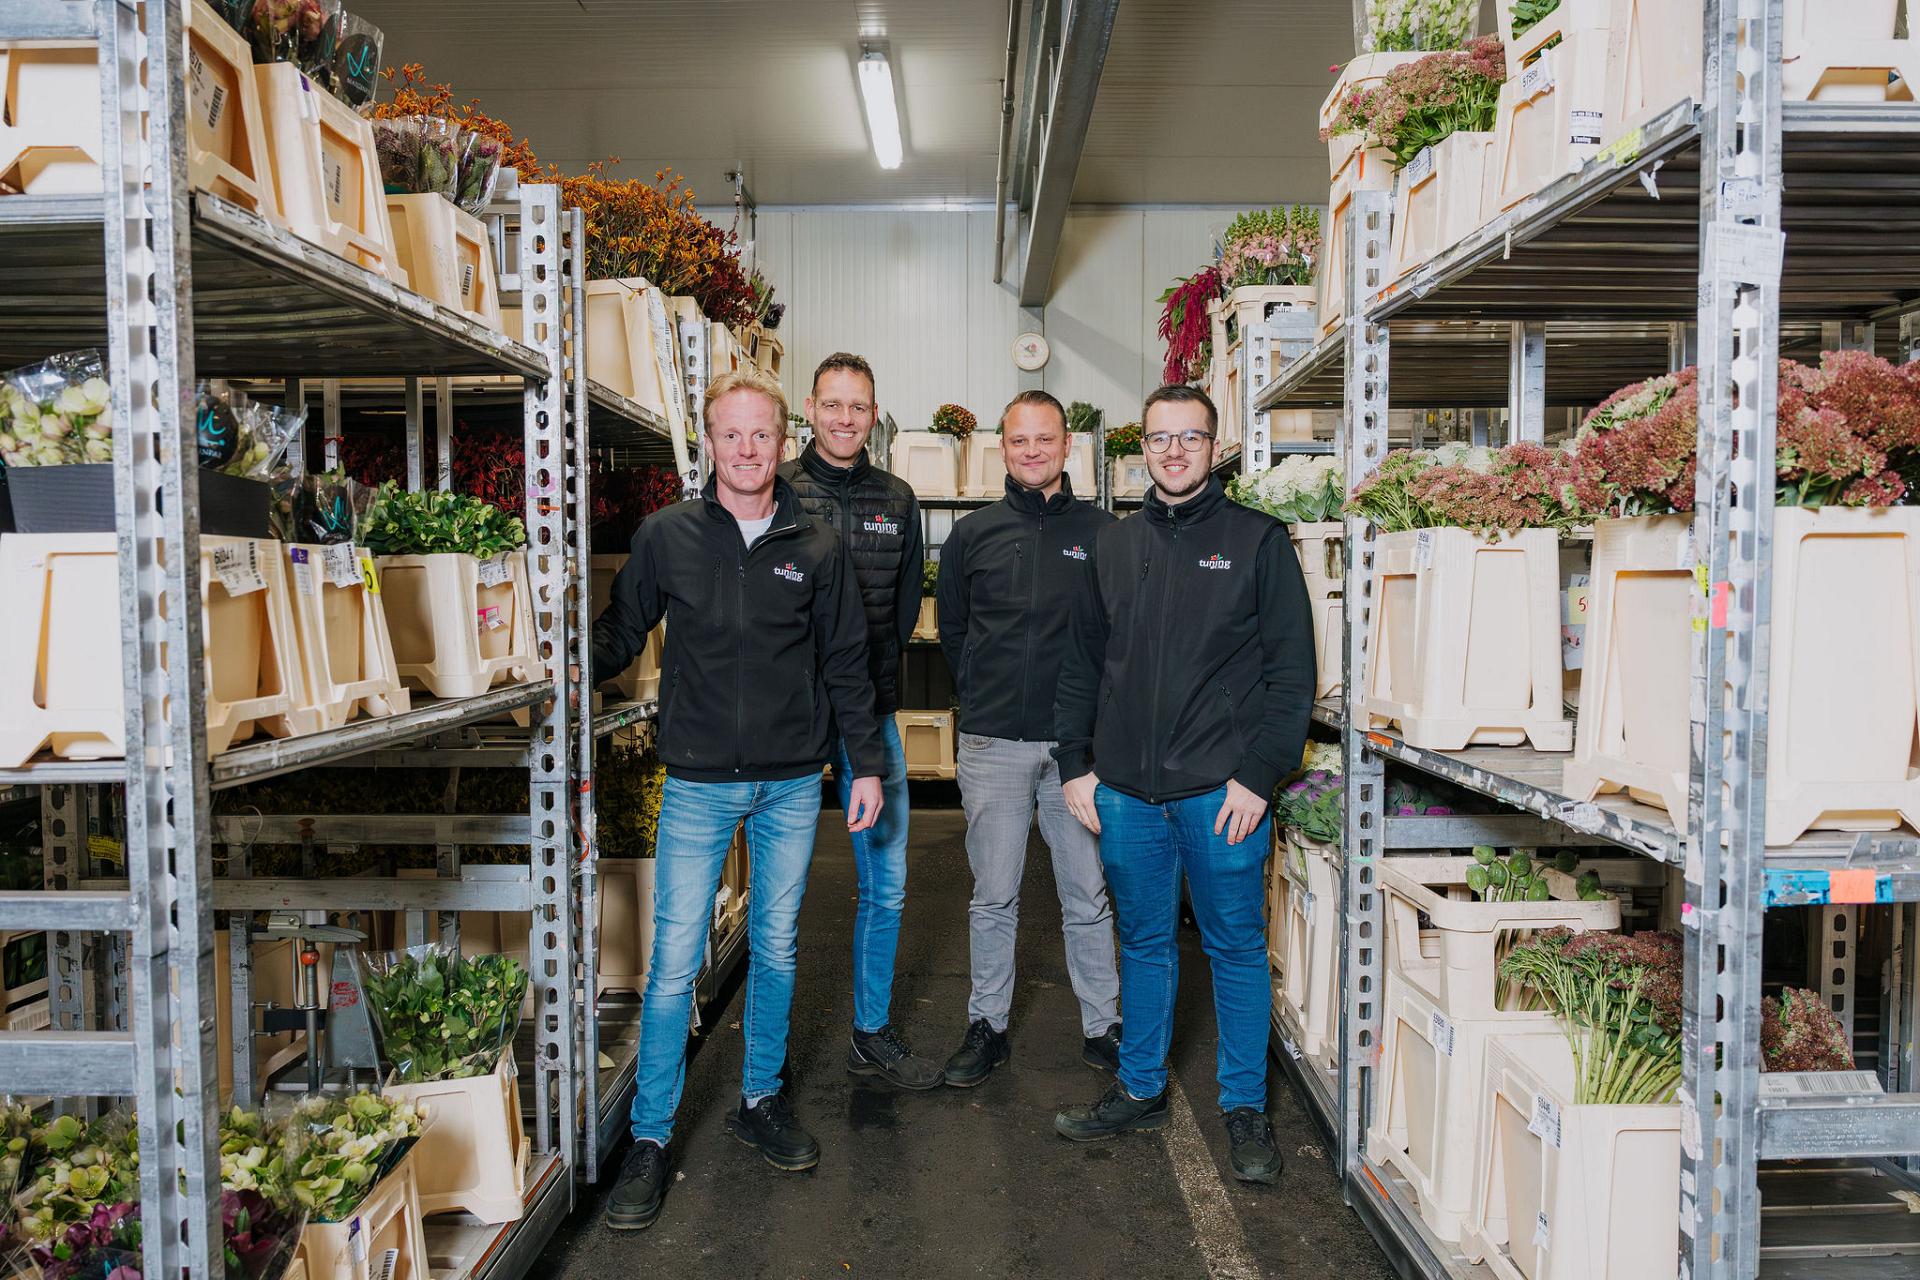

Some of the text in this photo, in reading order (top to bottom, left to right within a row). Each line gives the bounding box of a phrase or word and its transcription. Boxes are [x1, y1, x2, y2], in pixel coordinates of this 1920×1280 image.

[863, 520, 898, 535] tuning
[1199, 559, 1231, 570] tuning
[773, 566, 805, 582] tuning
